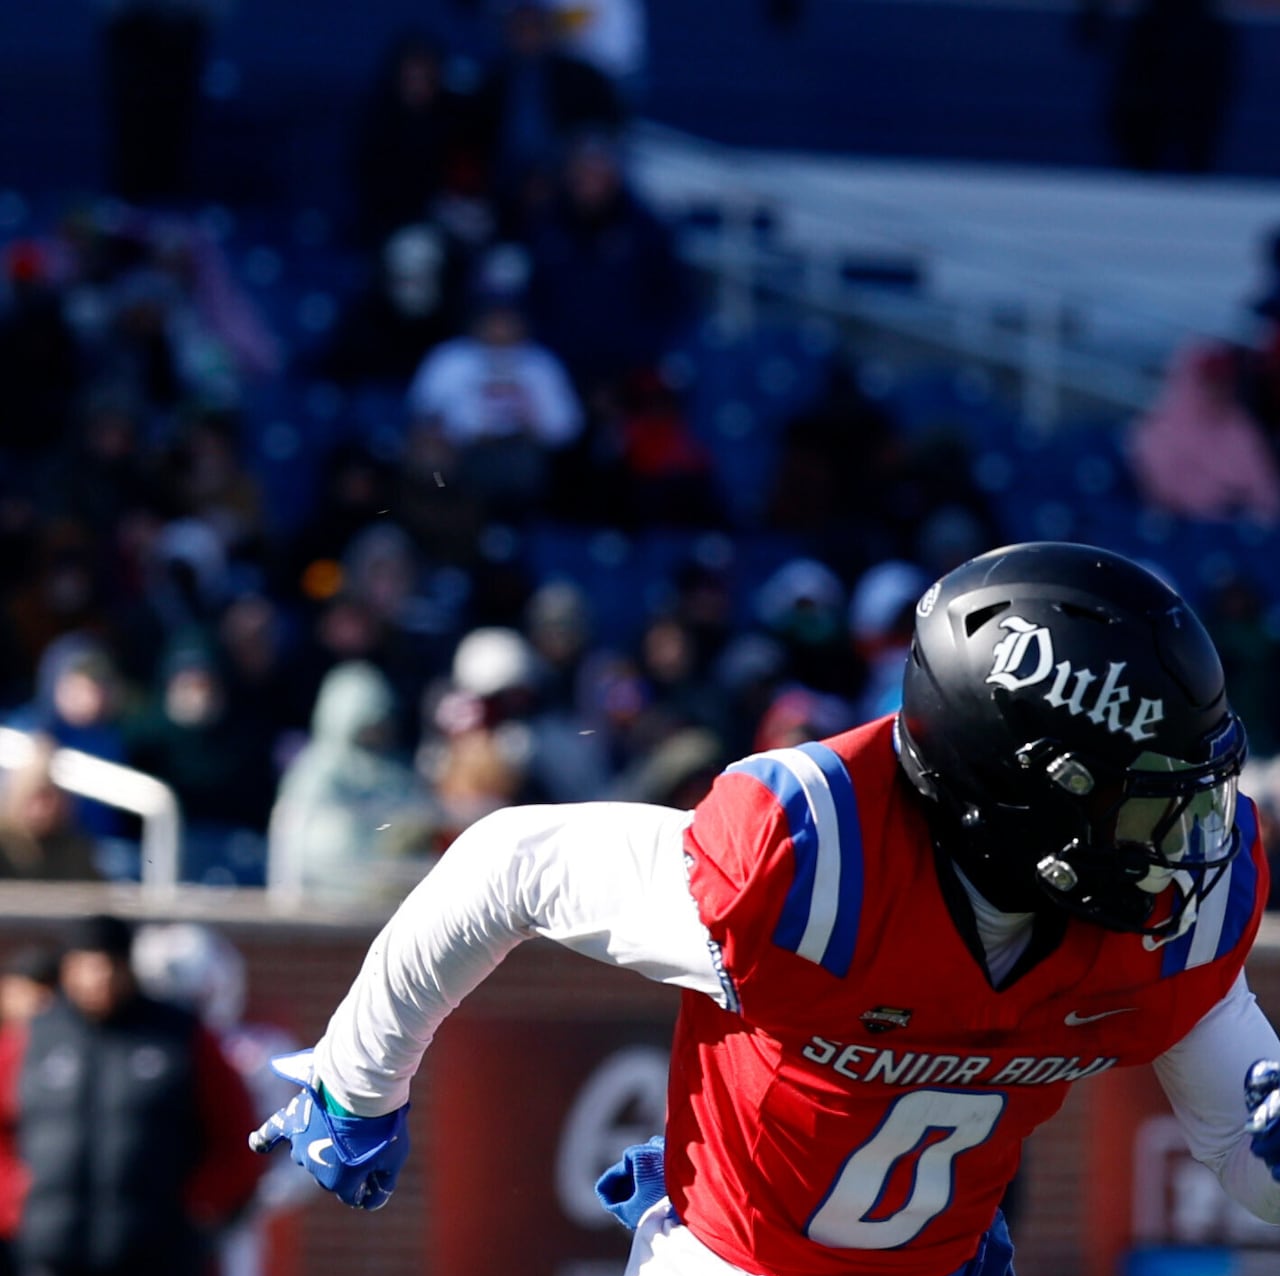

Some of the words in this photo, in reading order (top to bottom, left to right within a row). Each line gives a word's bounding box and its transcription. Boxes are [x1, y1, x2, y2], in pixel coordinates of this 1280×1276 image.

[985, 615, 1164, 742] Duke
[802, 1036, 991, 1085] SENIOR
[803, 1086, 1008, 1250] 0
